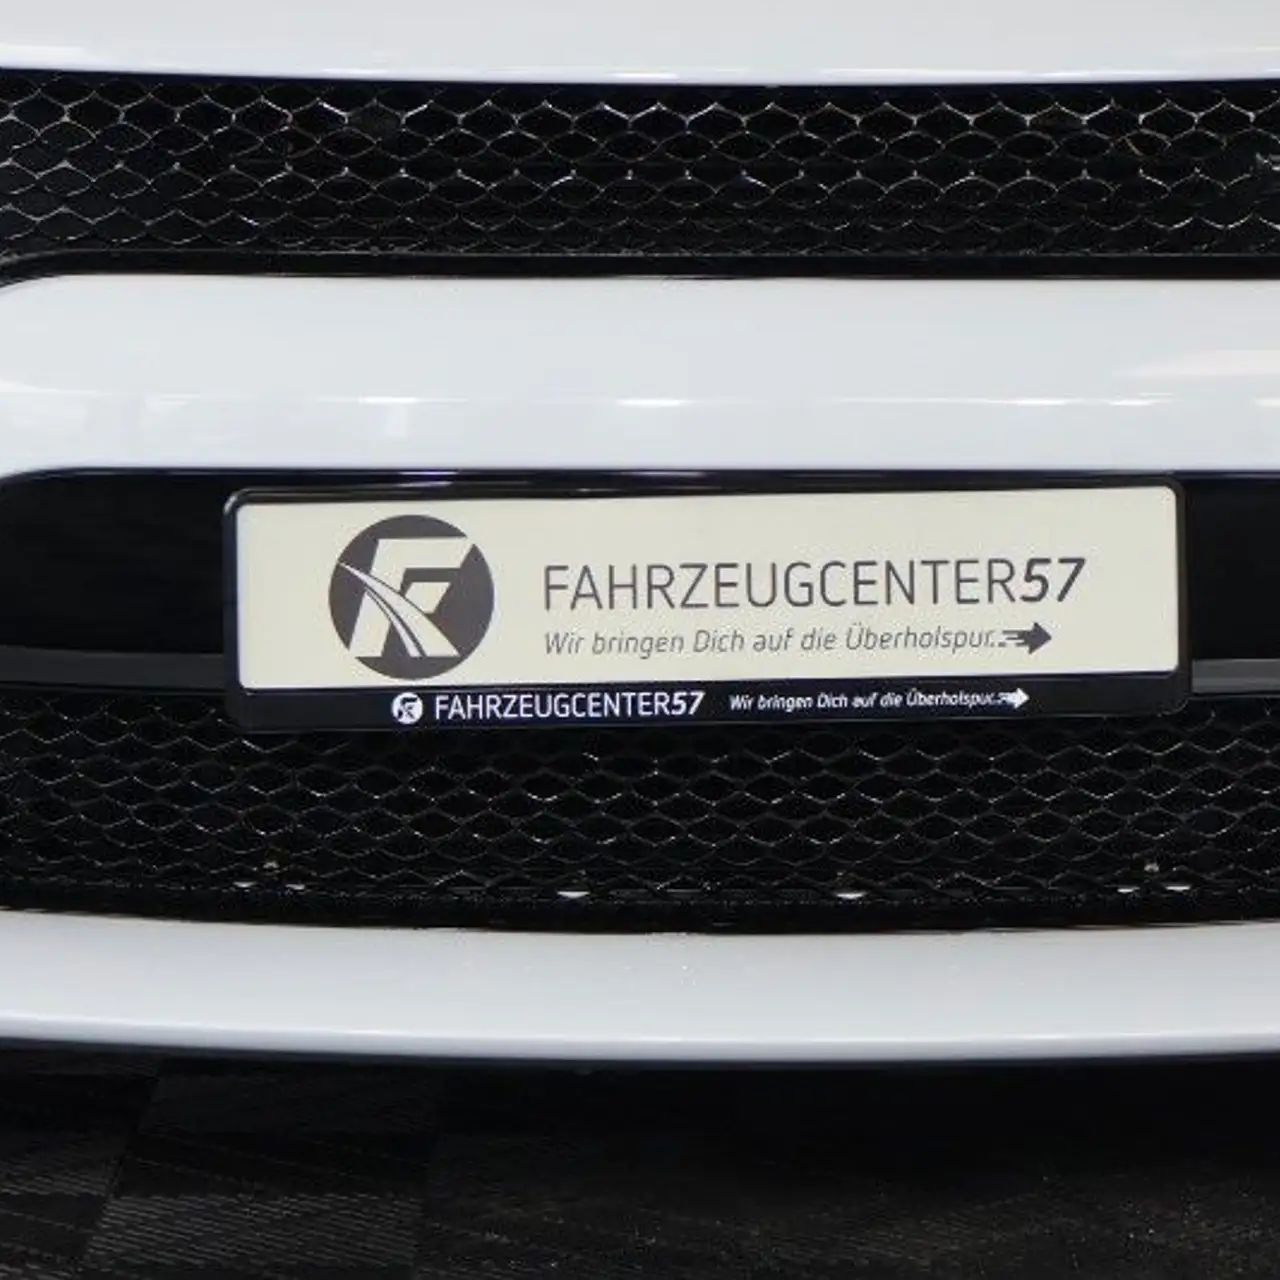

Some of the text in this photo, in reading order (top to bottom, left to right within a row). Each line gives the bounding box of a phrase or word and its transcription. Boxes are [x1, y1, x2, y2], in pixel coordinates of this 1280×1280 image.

[543, 557, 1086, 611] FAHRZEUGCENTER57
[545, 632, 585, 655] Wir
[591, 632, 685, 659] bringen
[693, 629, 745, 653] Dich
[752, 627, 794, 653] auf
[800, 627, 837, 651] die
[434, 691, 706, 720] FAHRZEUGCENTER57
[729, 694, 754, 711] Wir
[757, 694, 813, 713] bringen
[817, 693, 848, 709] Dich
[851, 692, 876, 708] auf
[879, 692, 901, 708] die
